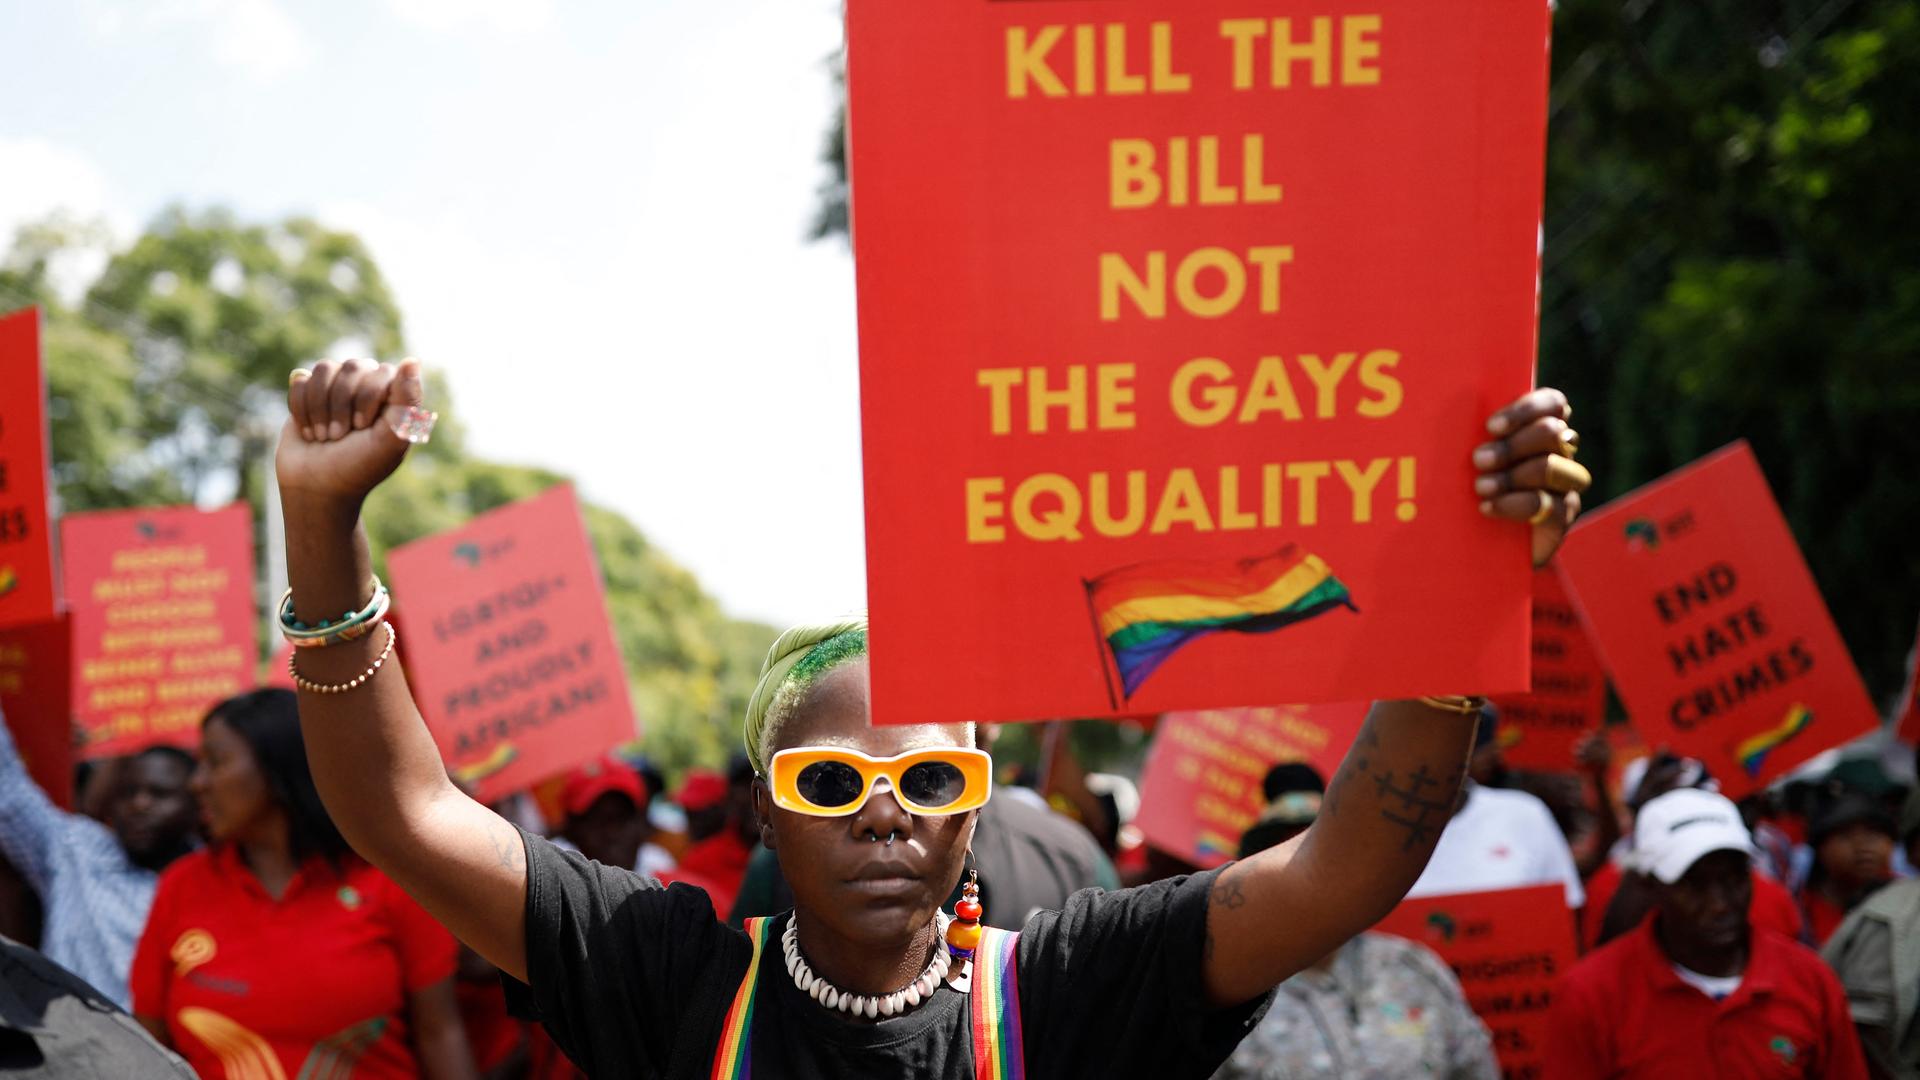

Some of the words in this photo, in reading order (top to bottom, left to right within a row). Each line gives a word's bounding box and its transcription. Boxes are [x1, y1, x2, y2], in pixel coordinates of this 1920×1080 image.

[1007, 23, 1190, 98] KILL
[1221, 16, 1380, 89] THE
[1110, 135, 1281, 208] BILL
[1100, 246, 1293, 320] NOT
[978, 363, 1135, 434] THE
[1171, 350, 1402, 426] GAYS
[966, 458, 1415, 542] EQUALITY!
[1653, 563, 1737, 625] END
[475, 619, 547, 662] AND
[1668, 605, 1769, 675] HATE
[444, 641, 592, 714] PROUDLY
[1669, 640, 1814, 731] CRIMES
